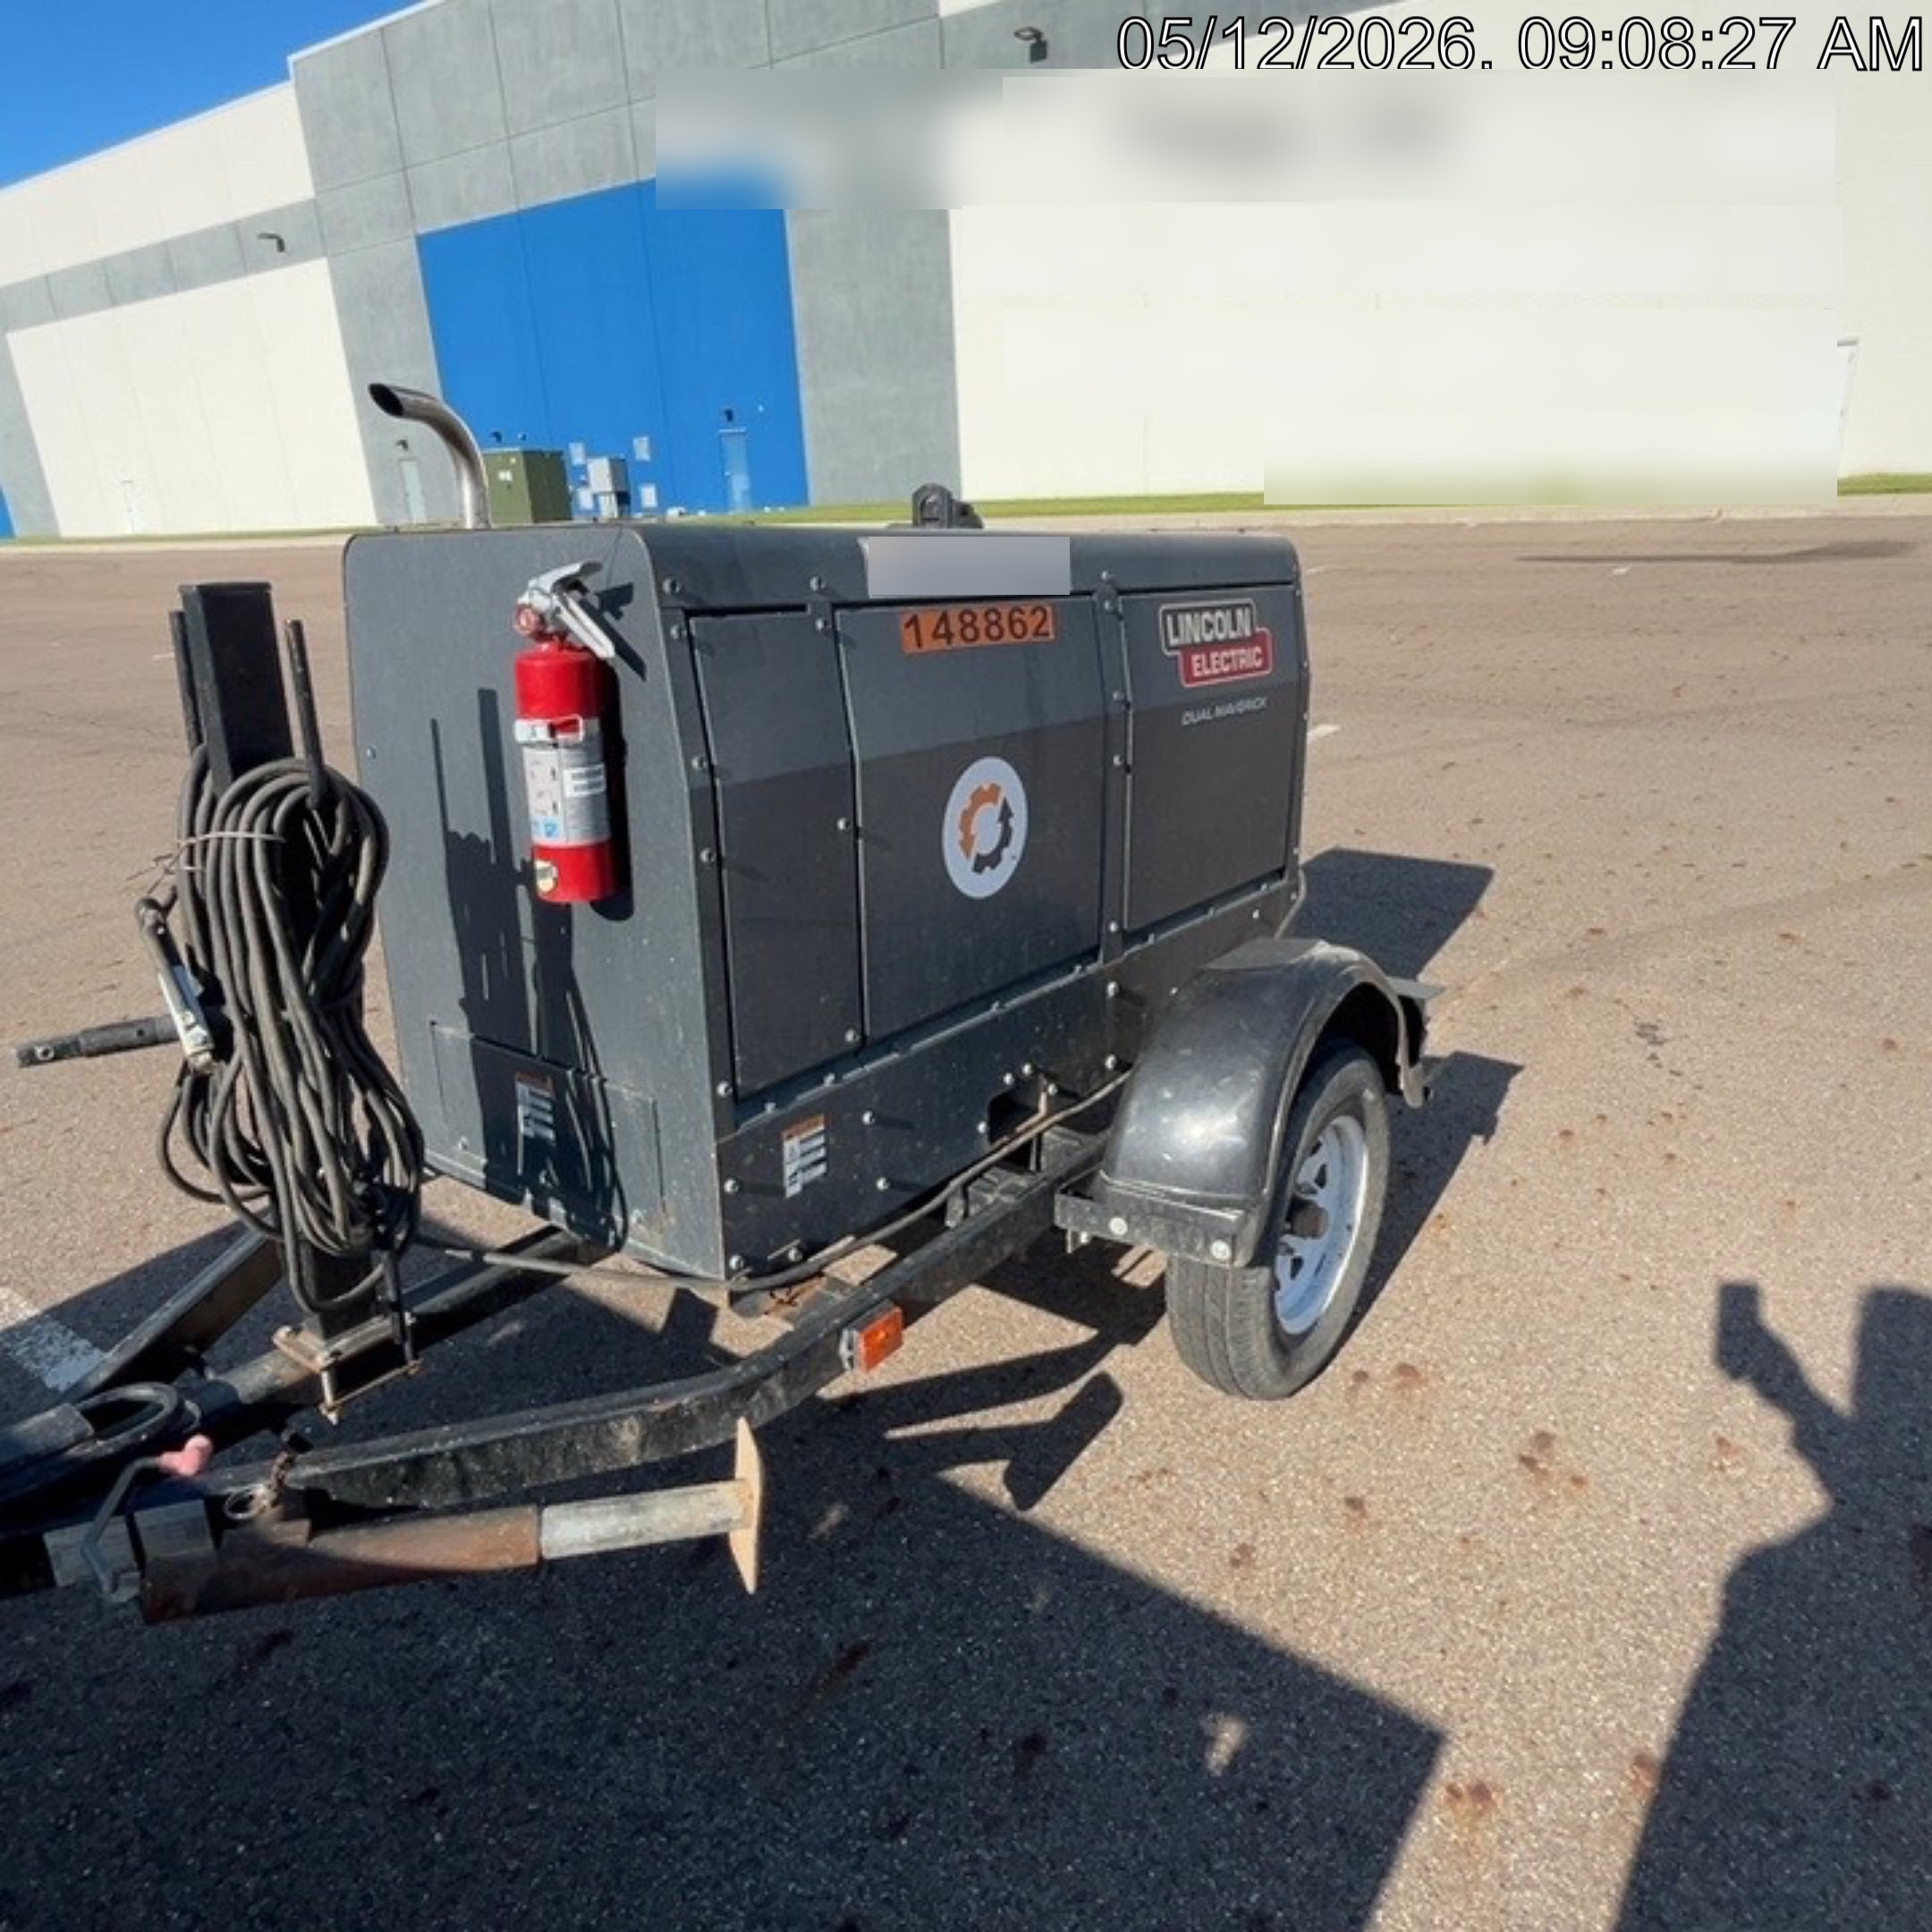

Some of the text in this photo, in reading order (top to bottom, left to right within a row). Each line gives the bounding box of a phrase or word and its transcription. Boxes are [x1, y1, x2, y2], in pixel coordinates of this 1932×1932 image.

[903, 606, 1051, 649] 148862
[1166, 608, 1251, 646] LINCOLN
[1191, 646, 1263, 677] ELECTRIC
